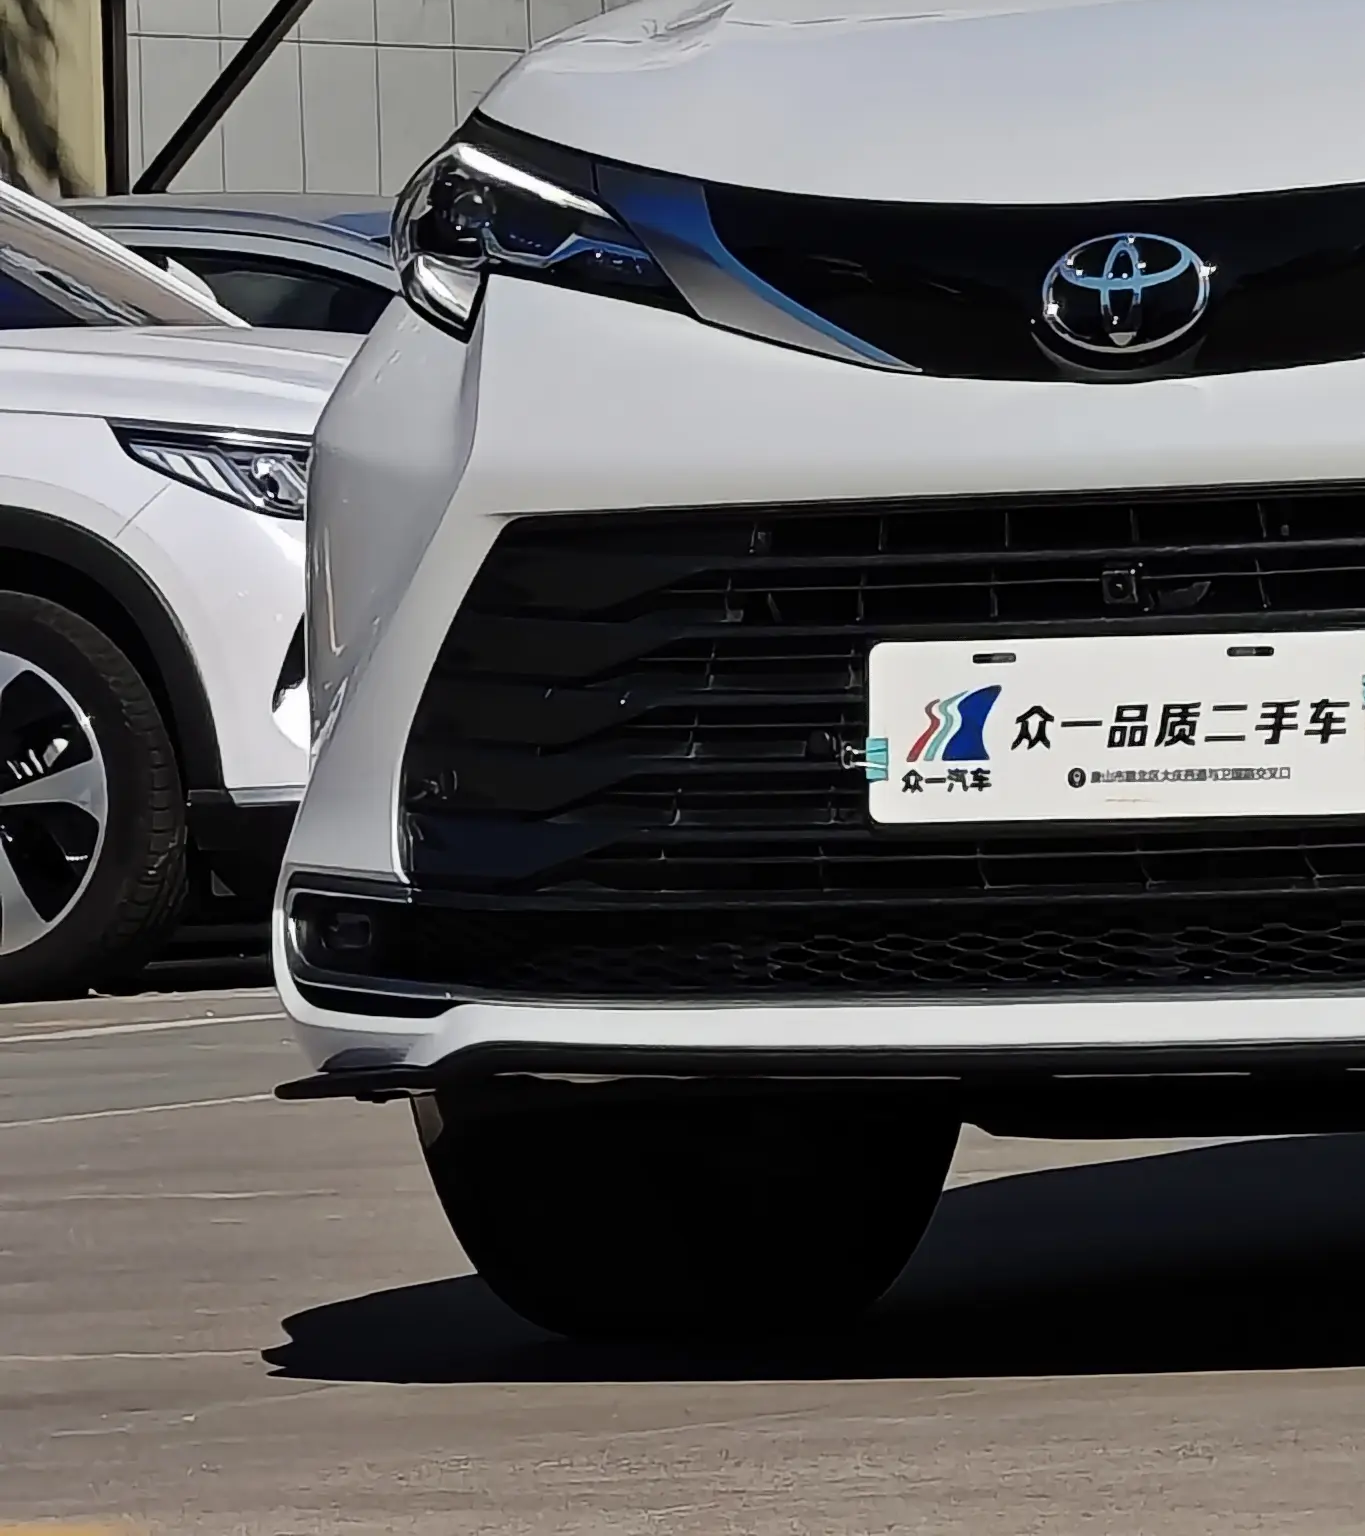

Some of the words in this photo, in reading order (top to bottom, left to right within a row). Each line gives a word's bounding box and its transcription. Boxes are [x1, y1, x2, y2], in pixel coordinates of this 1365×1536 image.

[1011, 699, 1350, 751] 众一品质二手车
[901, 767, 992, 794] 众一汽车
